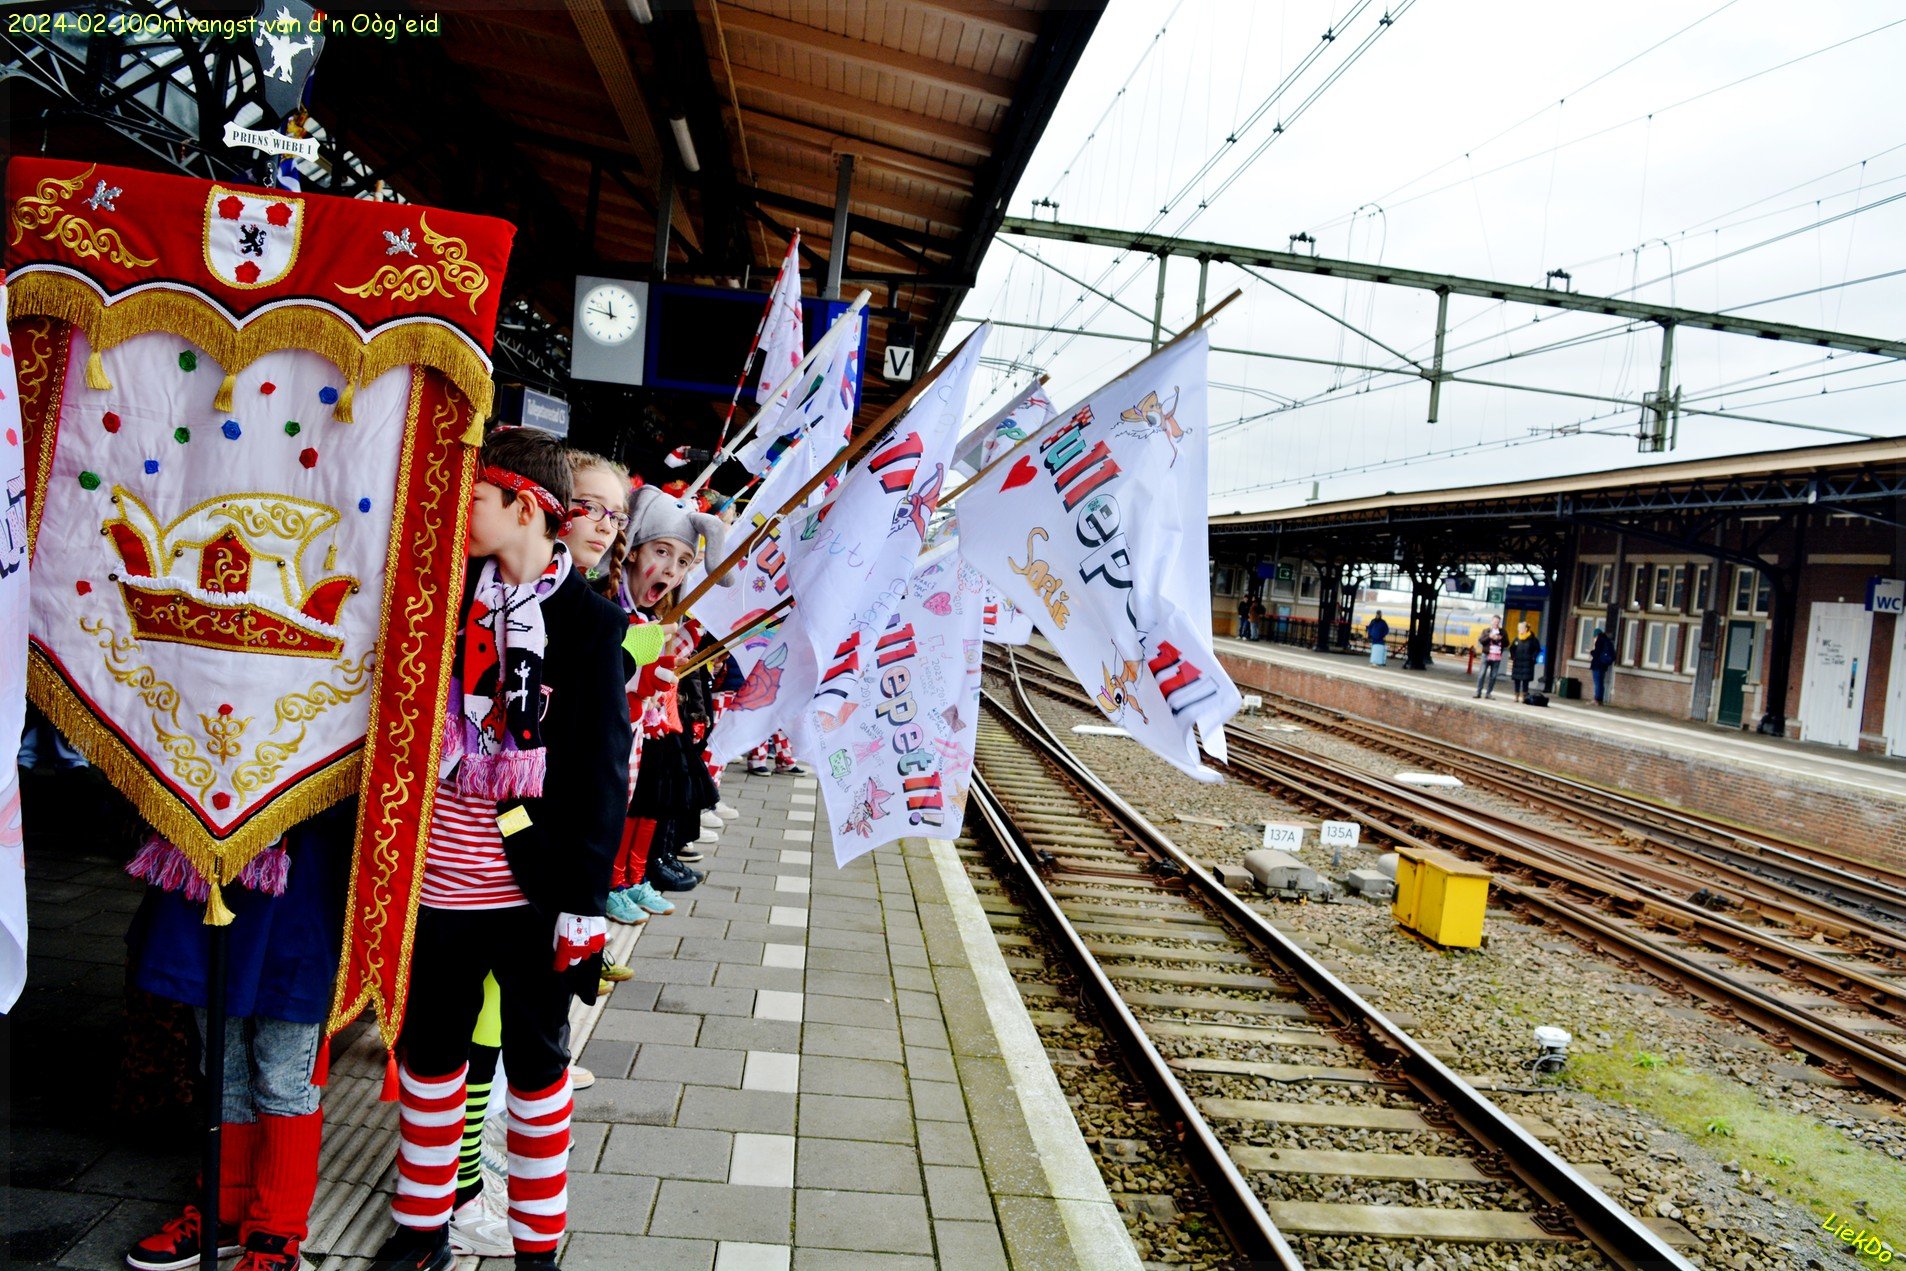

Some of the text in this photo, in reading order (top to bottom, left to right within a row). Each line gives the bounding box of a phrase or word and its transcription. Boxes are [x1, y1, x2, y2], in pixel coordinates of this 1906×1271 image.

[232, 130, 311, 155] PRIENS WIEBE I
[889, 348, 911, 377] V
[1876, 596, 1902, 611] WC
[1270, 829, 1296, 842] 137A
[1327, 826, 1353, 839] 135A
